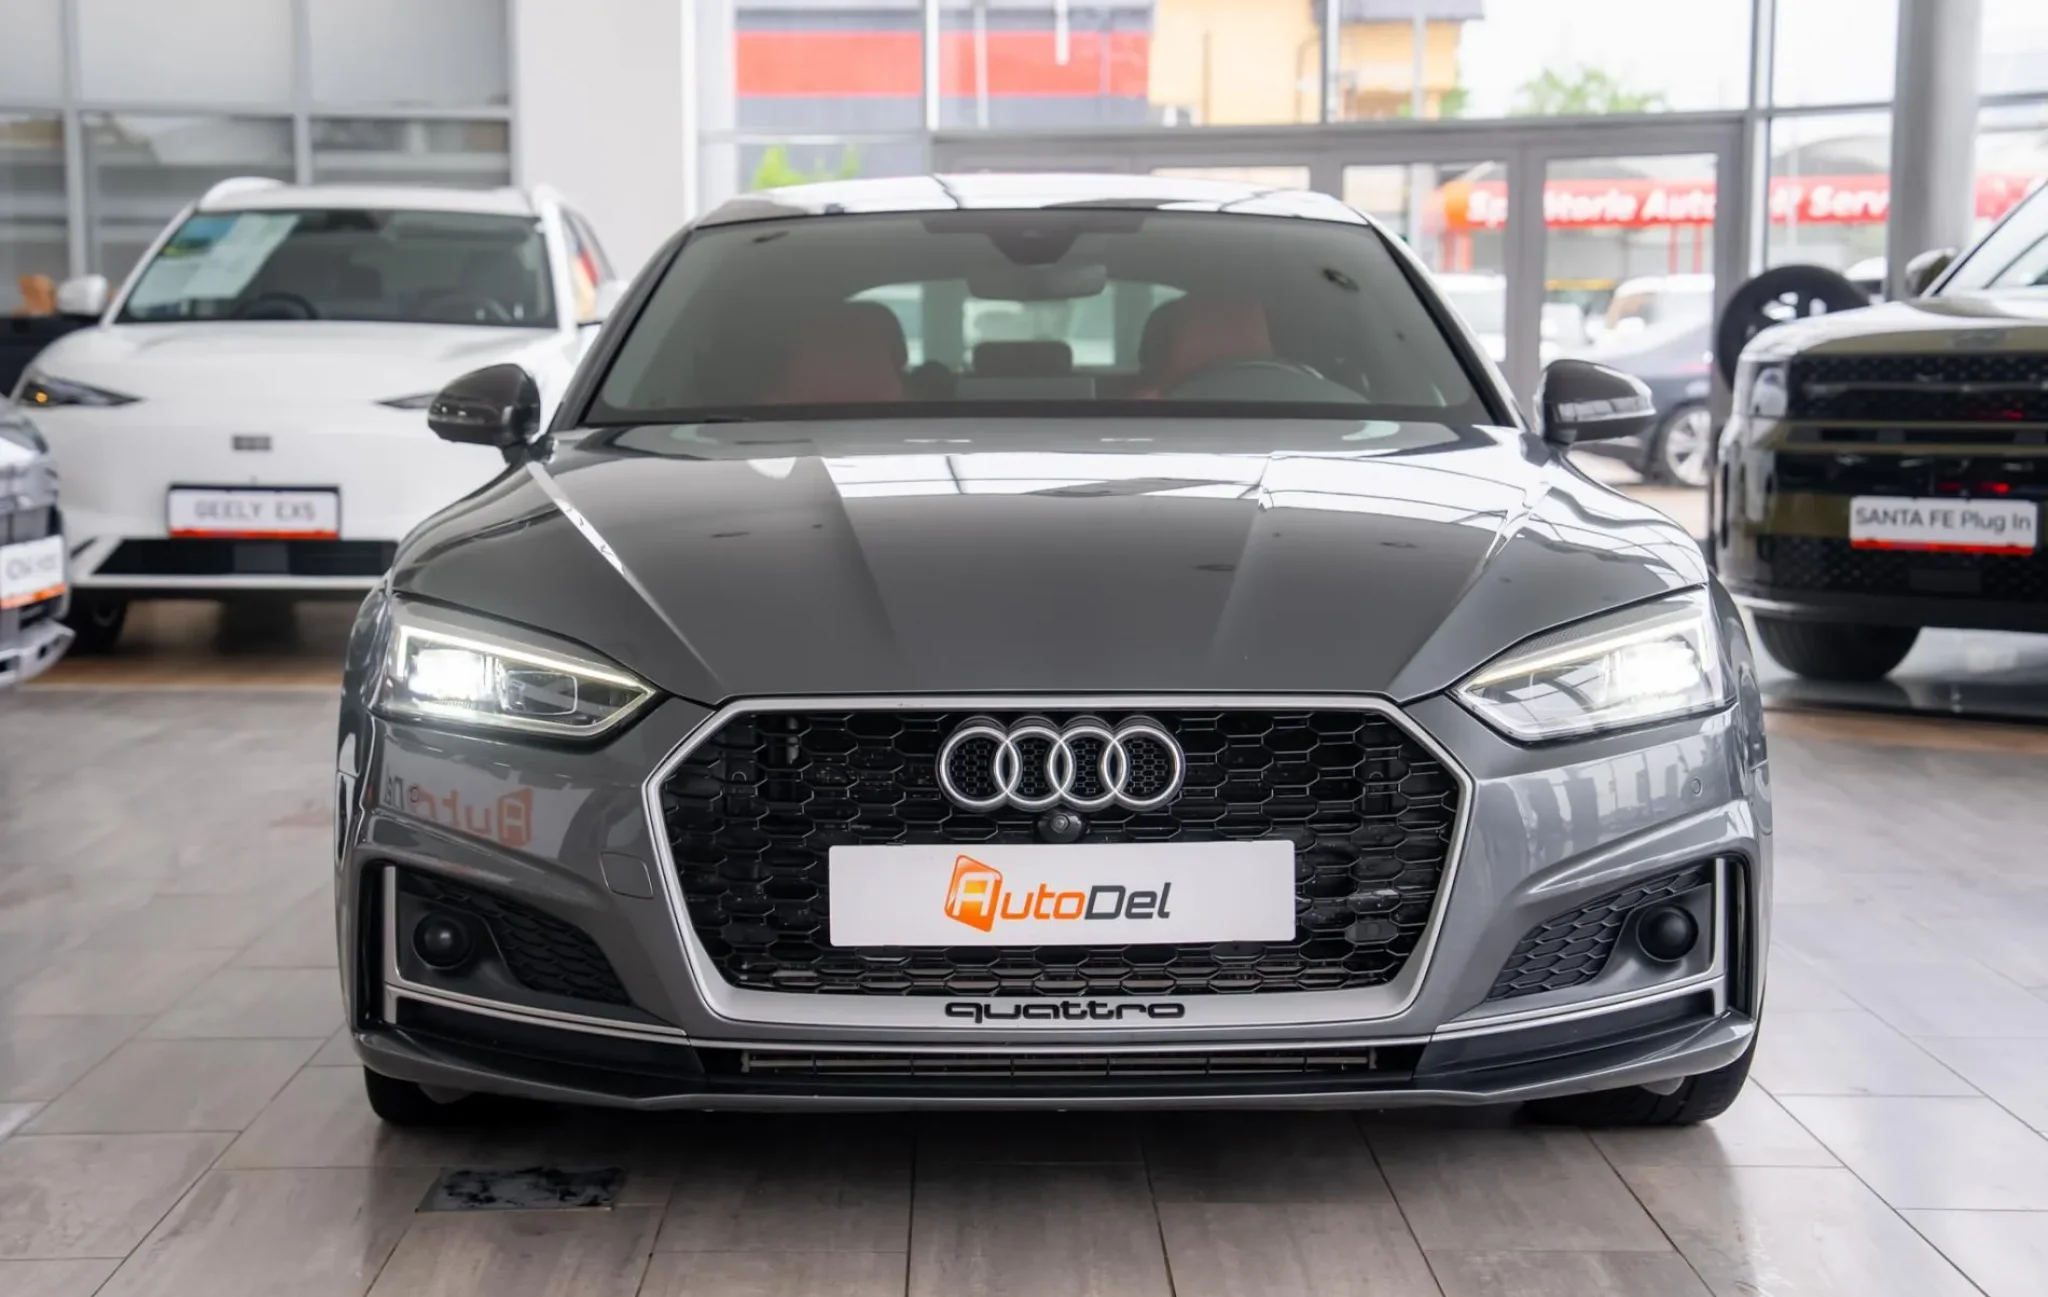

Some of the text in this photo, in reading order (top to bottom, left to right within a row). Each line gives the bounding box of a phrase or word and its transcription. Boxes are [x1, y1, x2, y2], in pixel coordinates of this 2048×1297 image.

[1810, 185, 1889, 218] Serv
[194, 500, 264, 522] GEELY
[1855, 507, 2031, 534] SANTA FE Plug In
[946, 866, 1172, 924] AutoDel
[945, 1001, 1185, 1023] quattro
